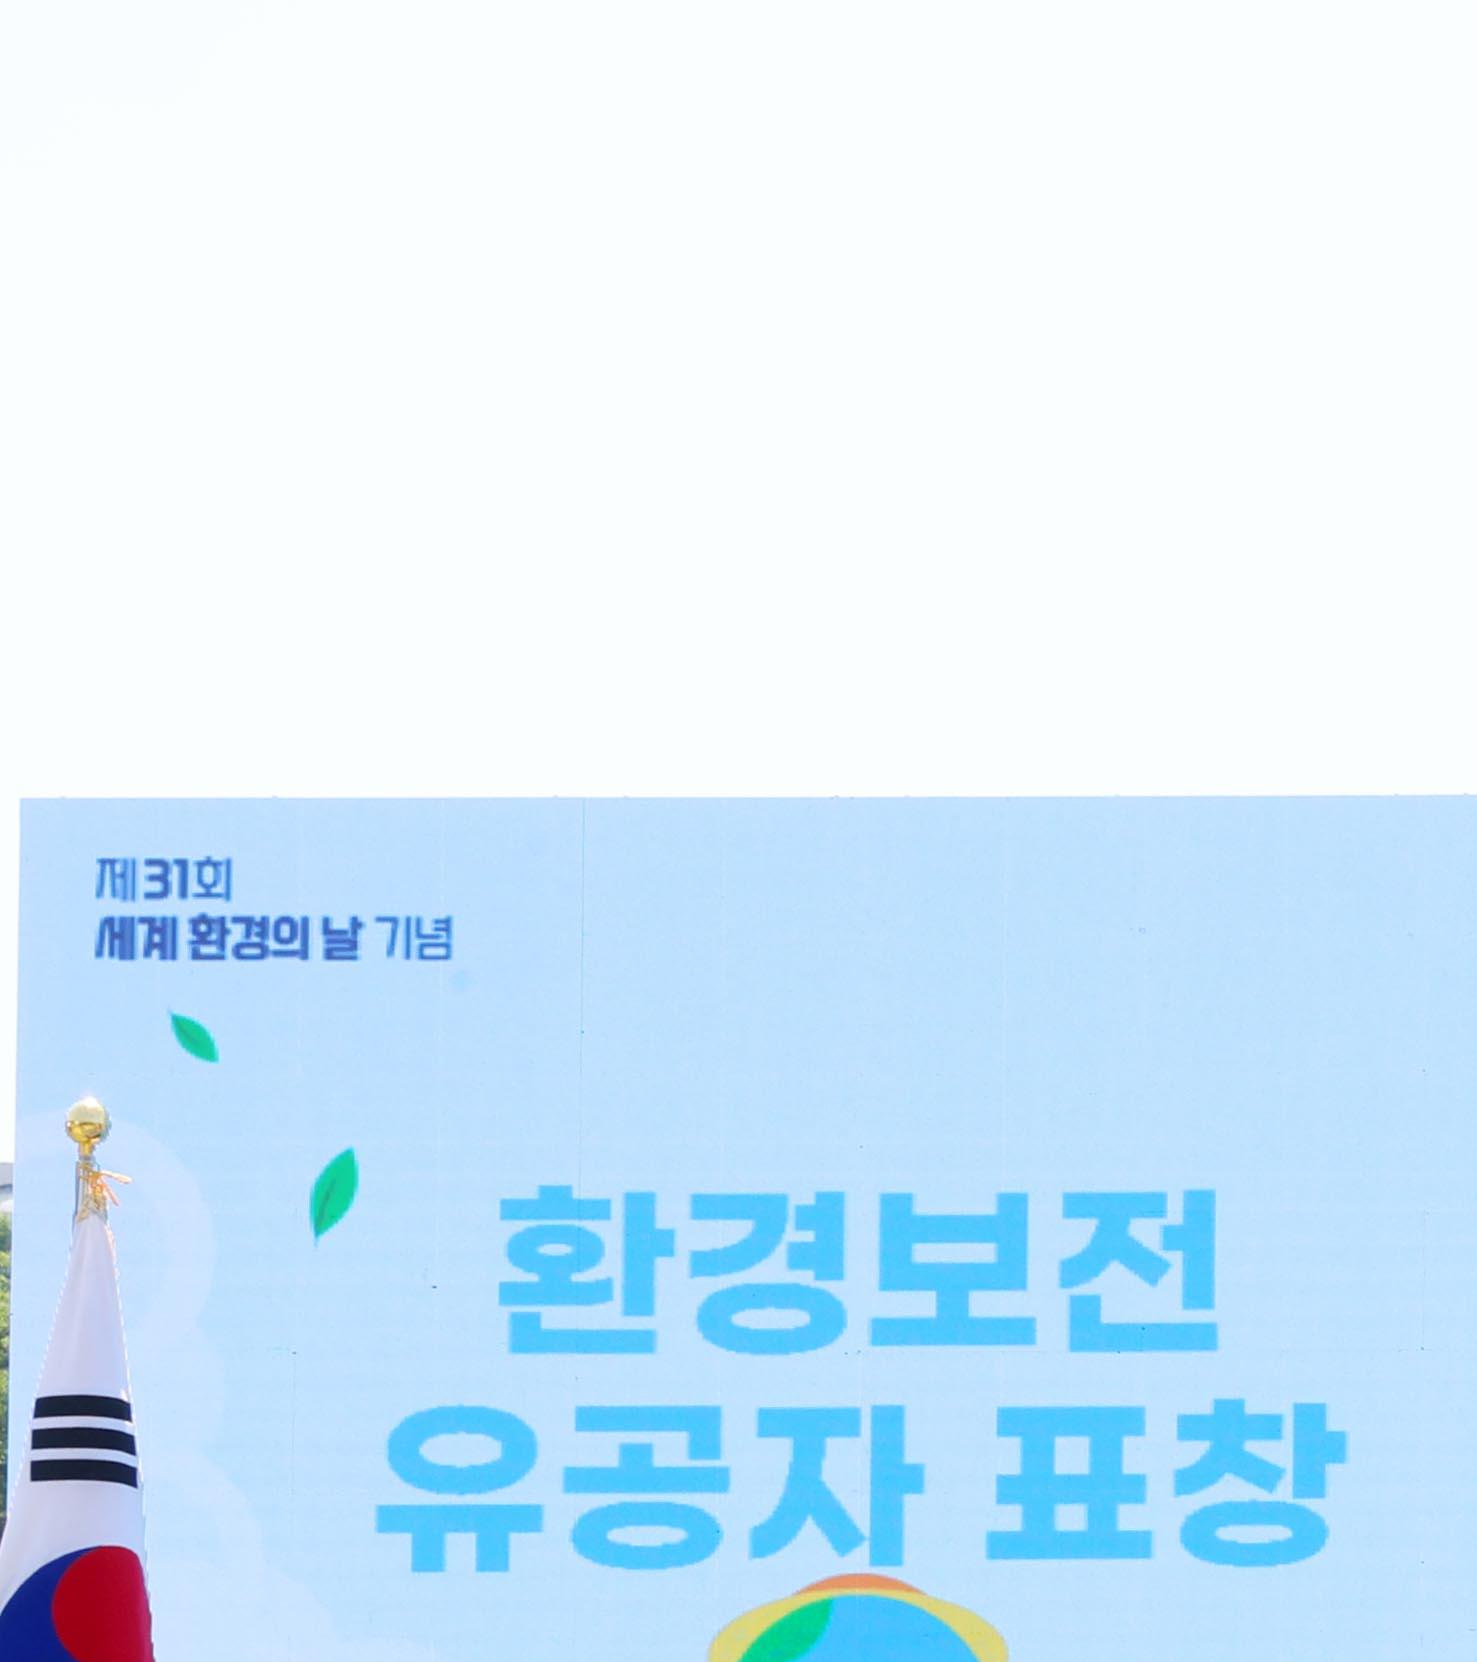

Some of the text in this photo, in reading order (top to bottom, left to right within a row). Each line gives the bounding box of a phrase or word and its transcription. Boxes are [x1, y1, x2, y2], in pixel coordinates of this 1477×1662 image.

[95, 856, 232, 902] 제31회
[95, 912, 453, 961] 세계 환경의 날 기념
[498, 1184, 1218, 1355] 환경보전
[375, 1398, 1347, 1573] 유공자 표창
